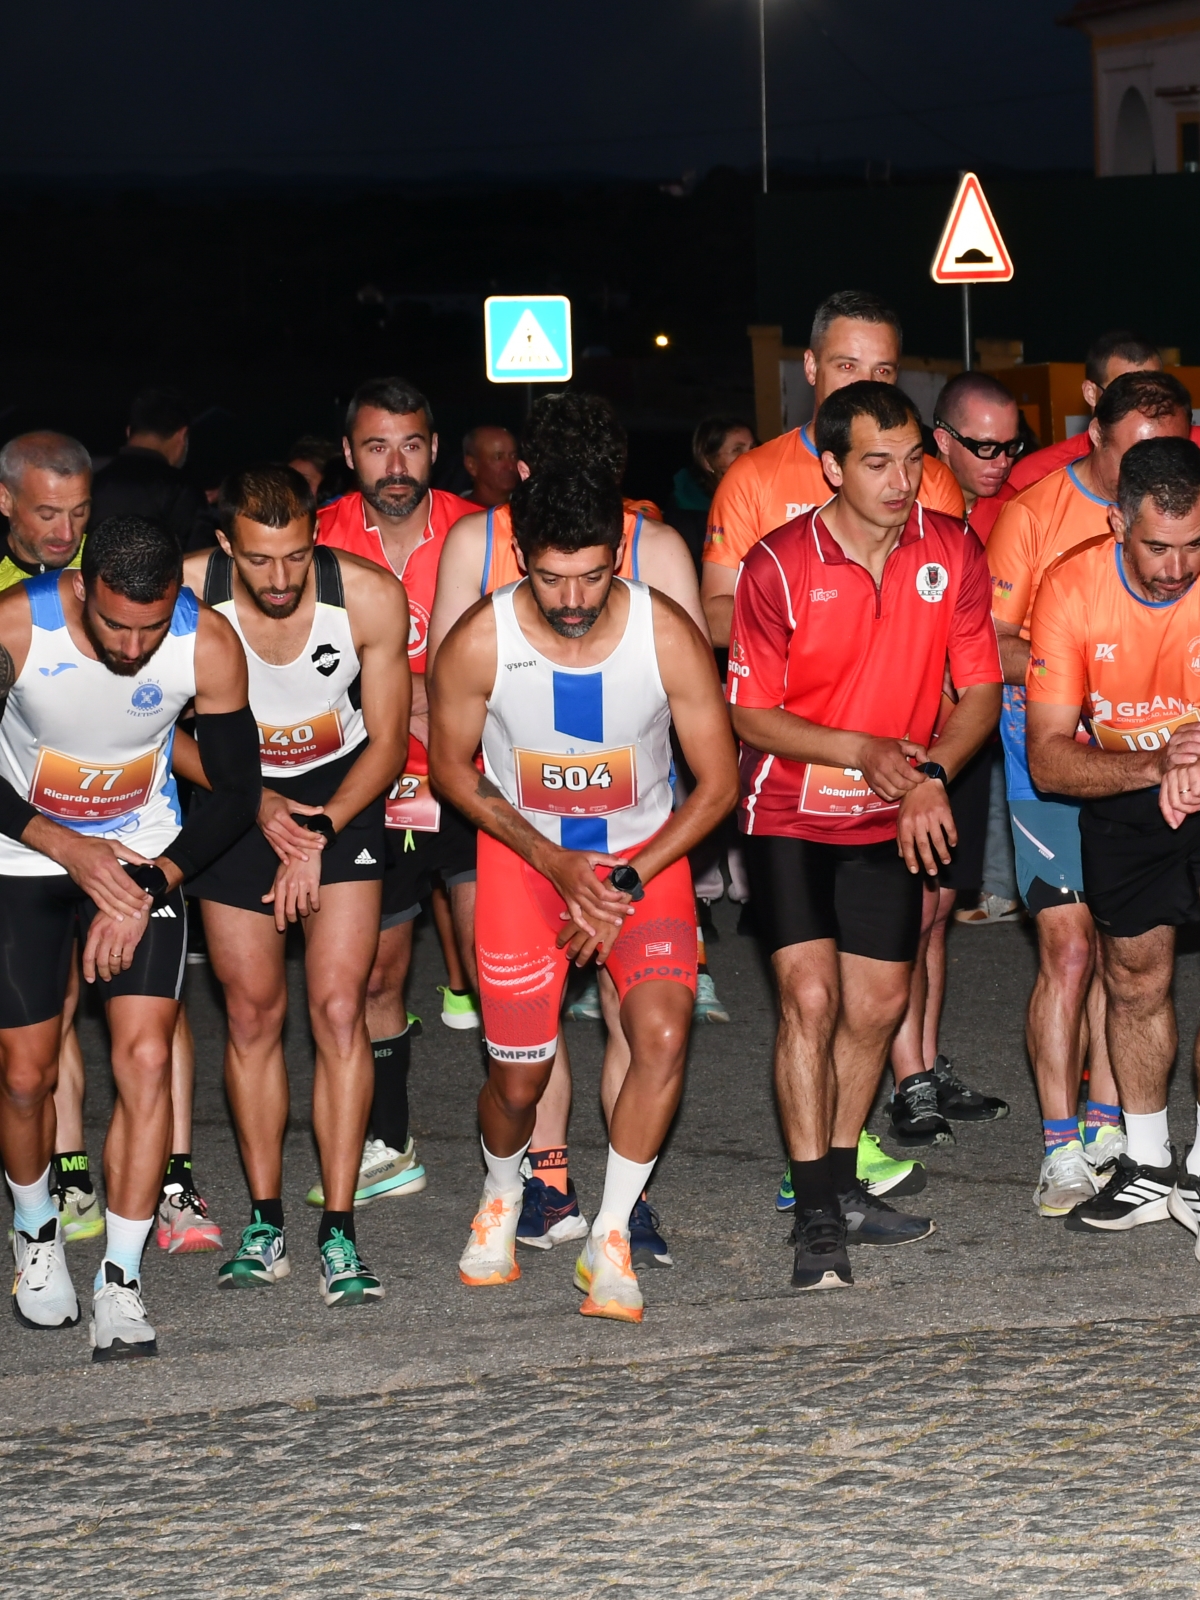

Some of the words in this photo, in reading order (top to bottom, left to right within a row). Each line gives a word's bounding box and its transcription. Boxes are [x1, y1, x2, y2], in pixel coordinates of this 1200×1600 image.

[78, 767, 124, 792] 77
[541, 762, 613, 792] 504
[43, 787, 90, 804] Ricardo
[91, 788, 144, 804] Bernardo
[818, 785, 866, 799] Joaquim
